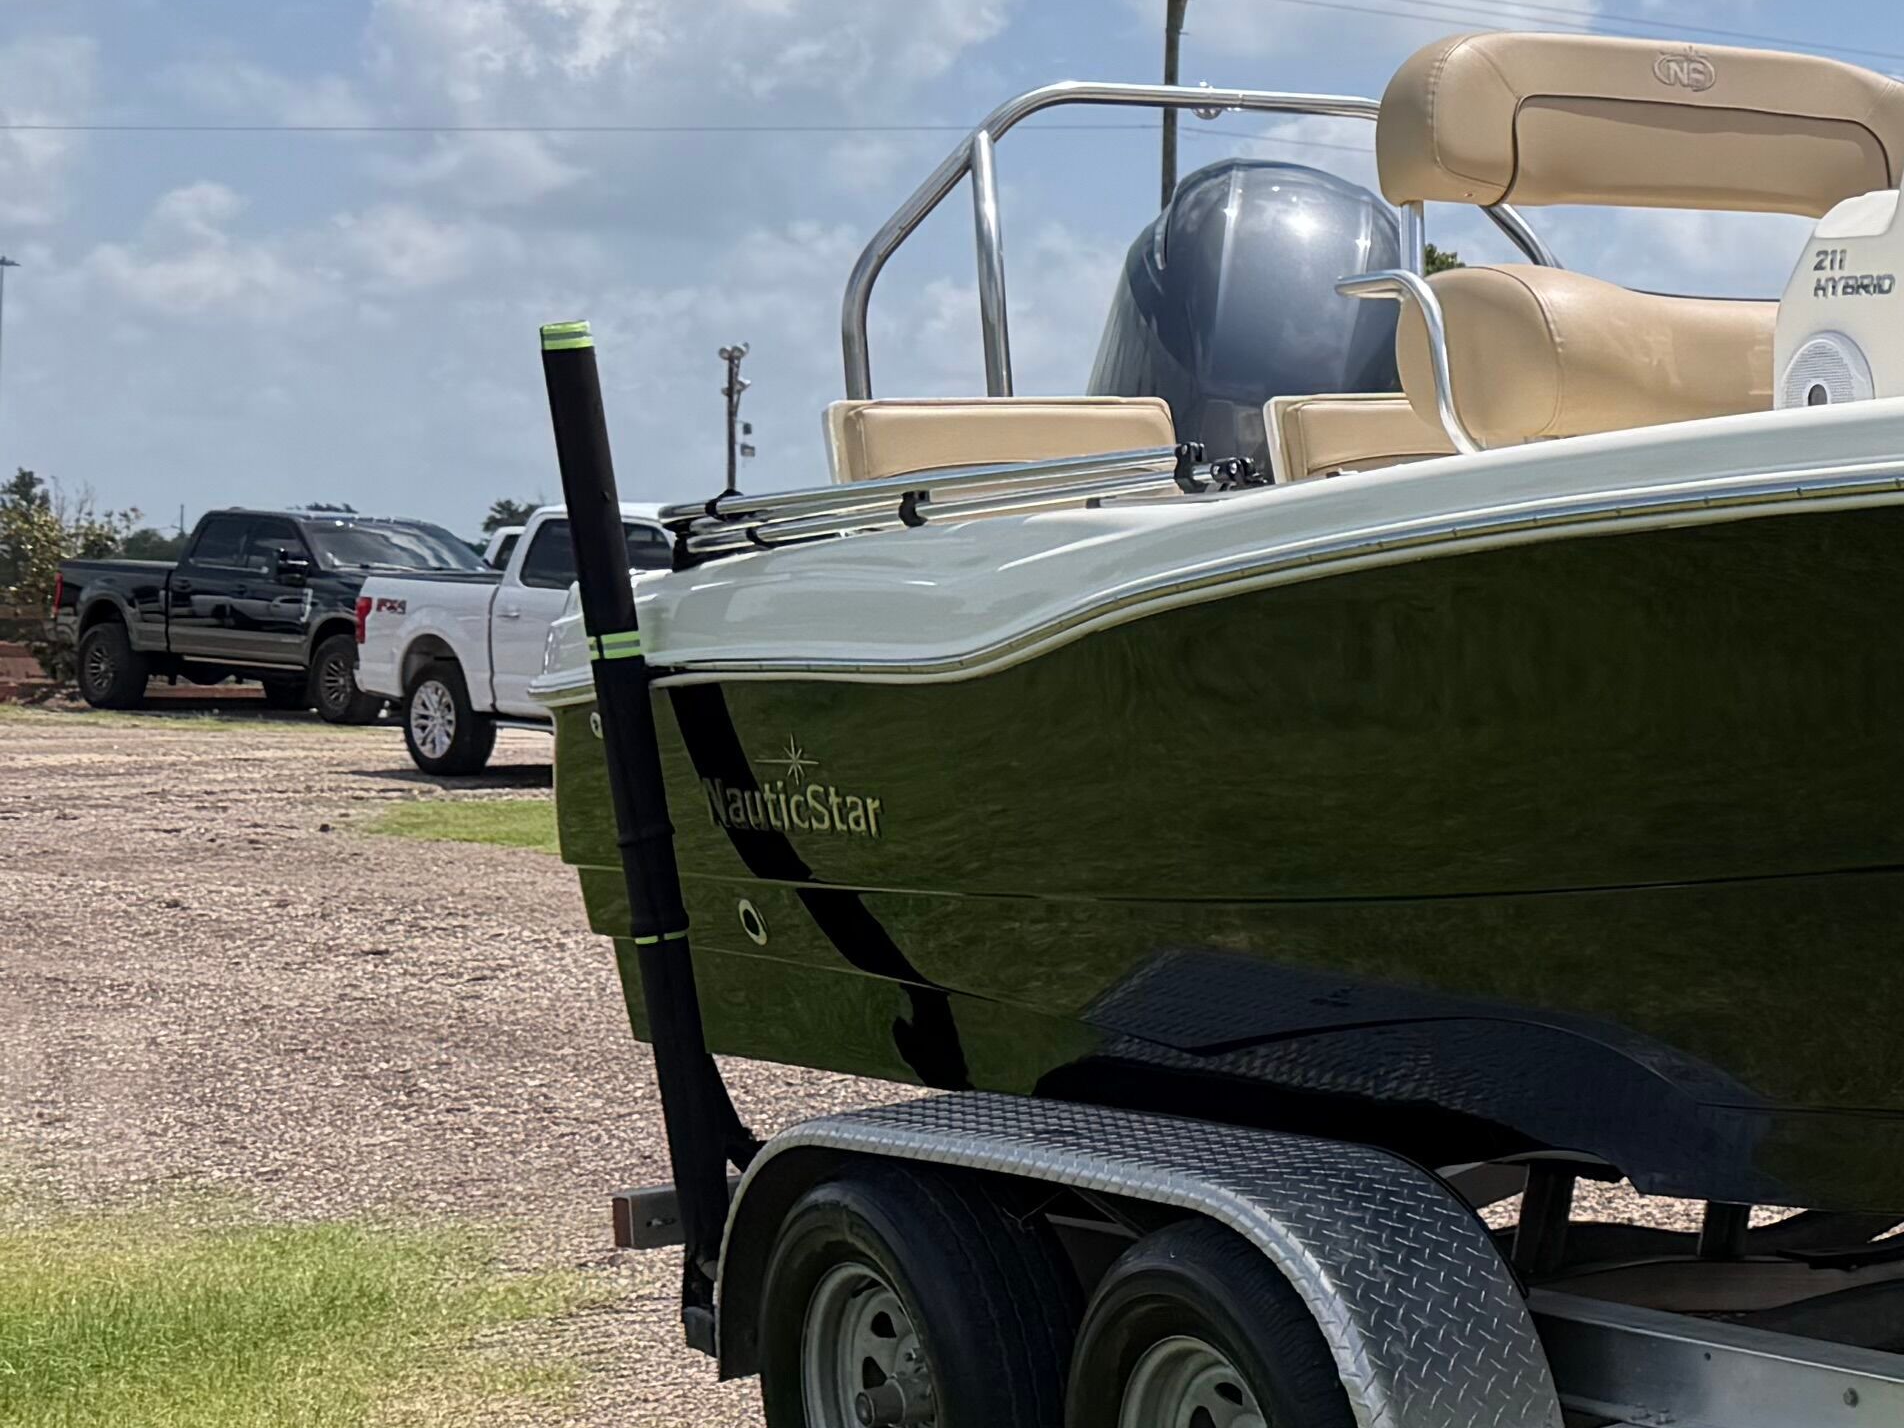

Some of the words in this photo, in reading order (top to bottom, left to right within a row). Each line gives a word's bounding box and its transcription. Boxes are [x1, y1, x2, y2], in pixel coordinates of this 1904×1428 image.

[1813, 249, 1847, 271] 211
[1813, 274, 1896, 297] HYBRID
[376, 597, 407, 615] FX4
[703, 777, 881, 839] NauticStar
